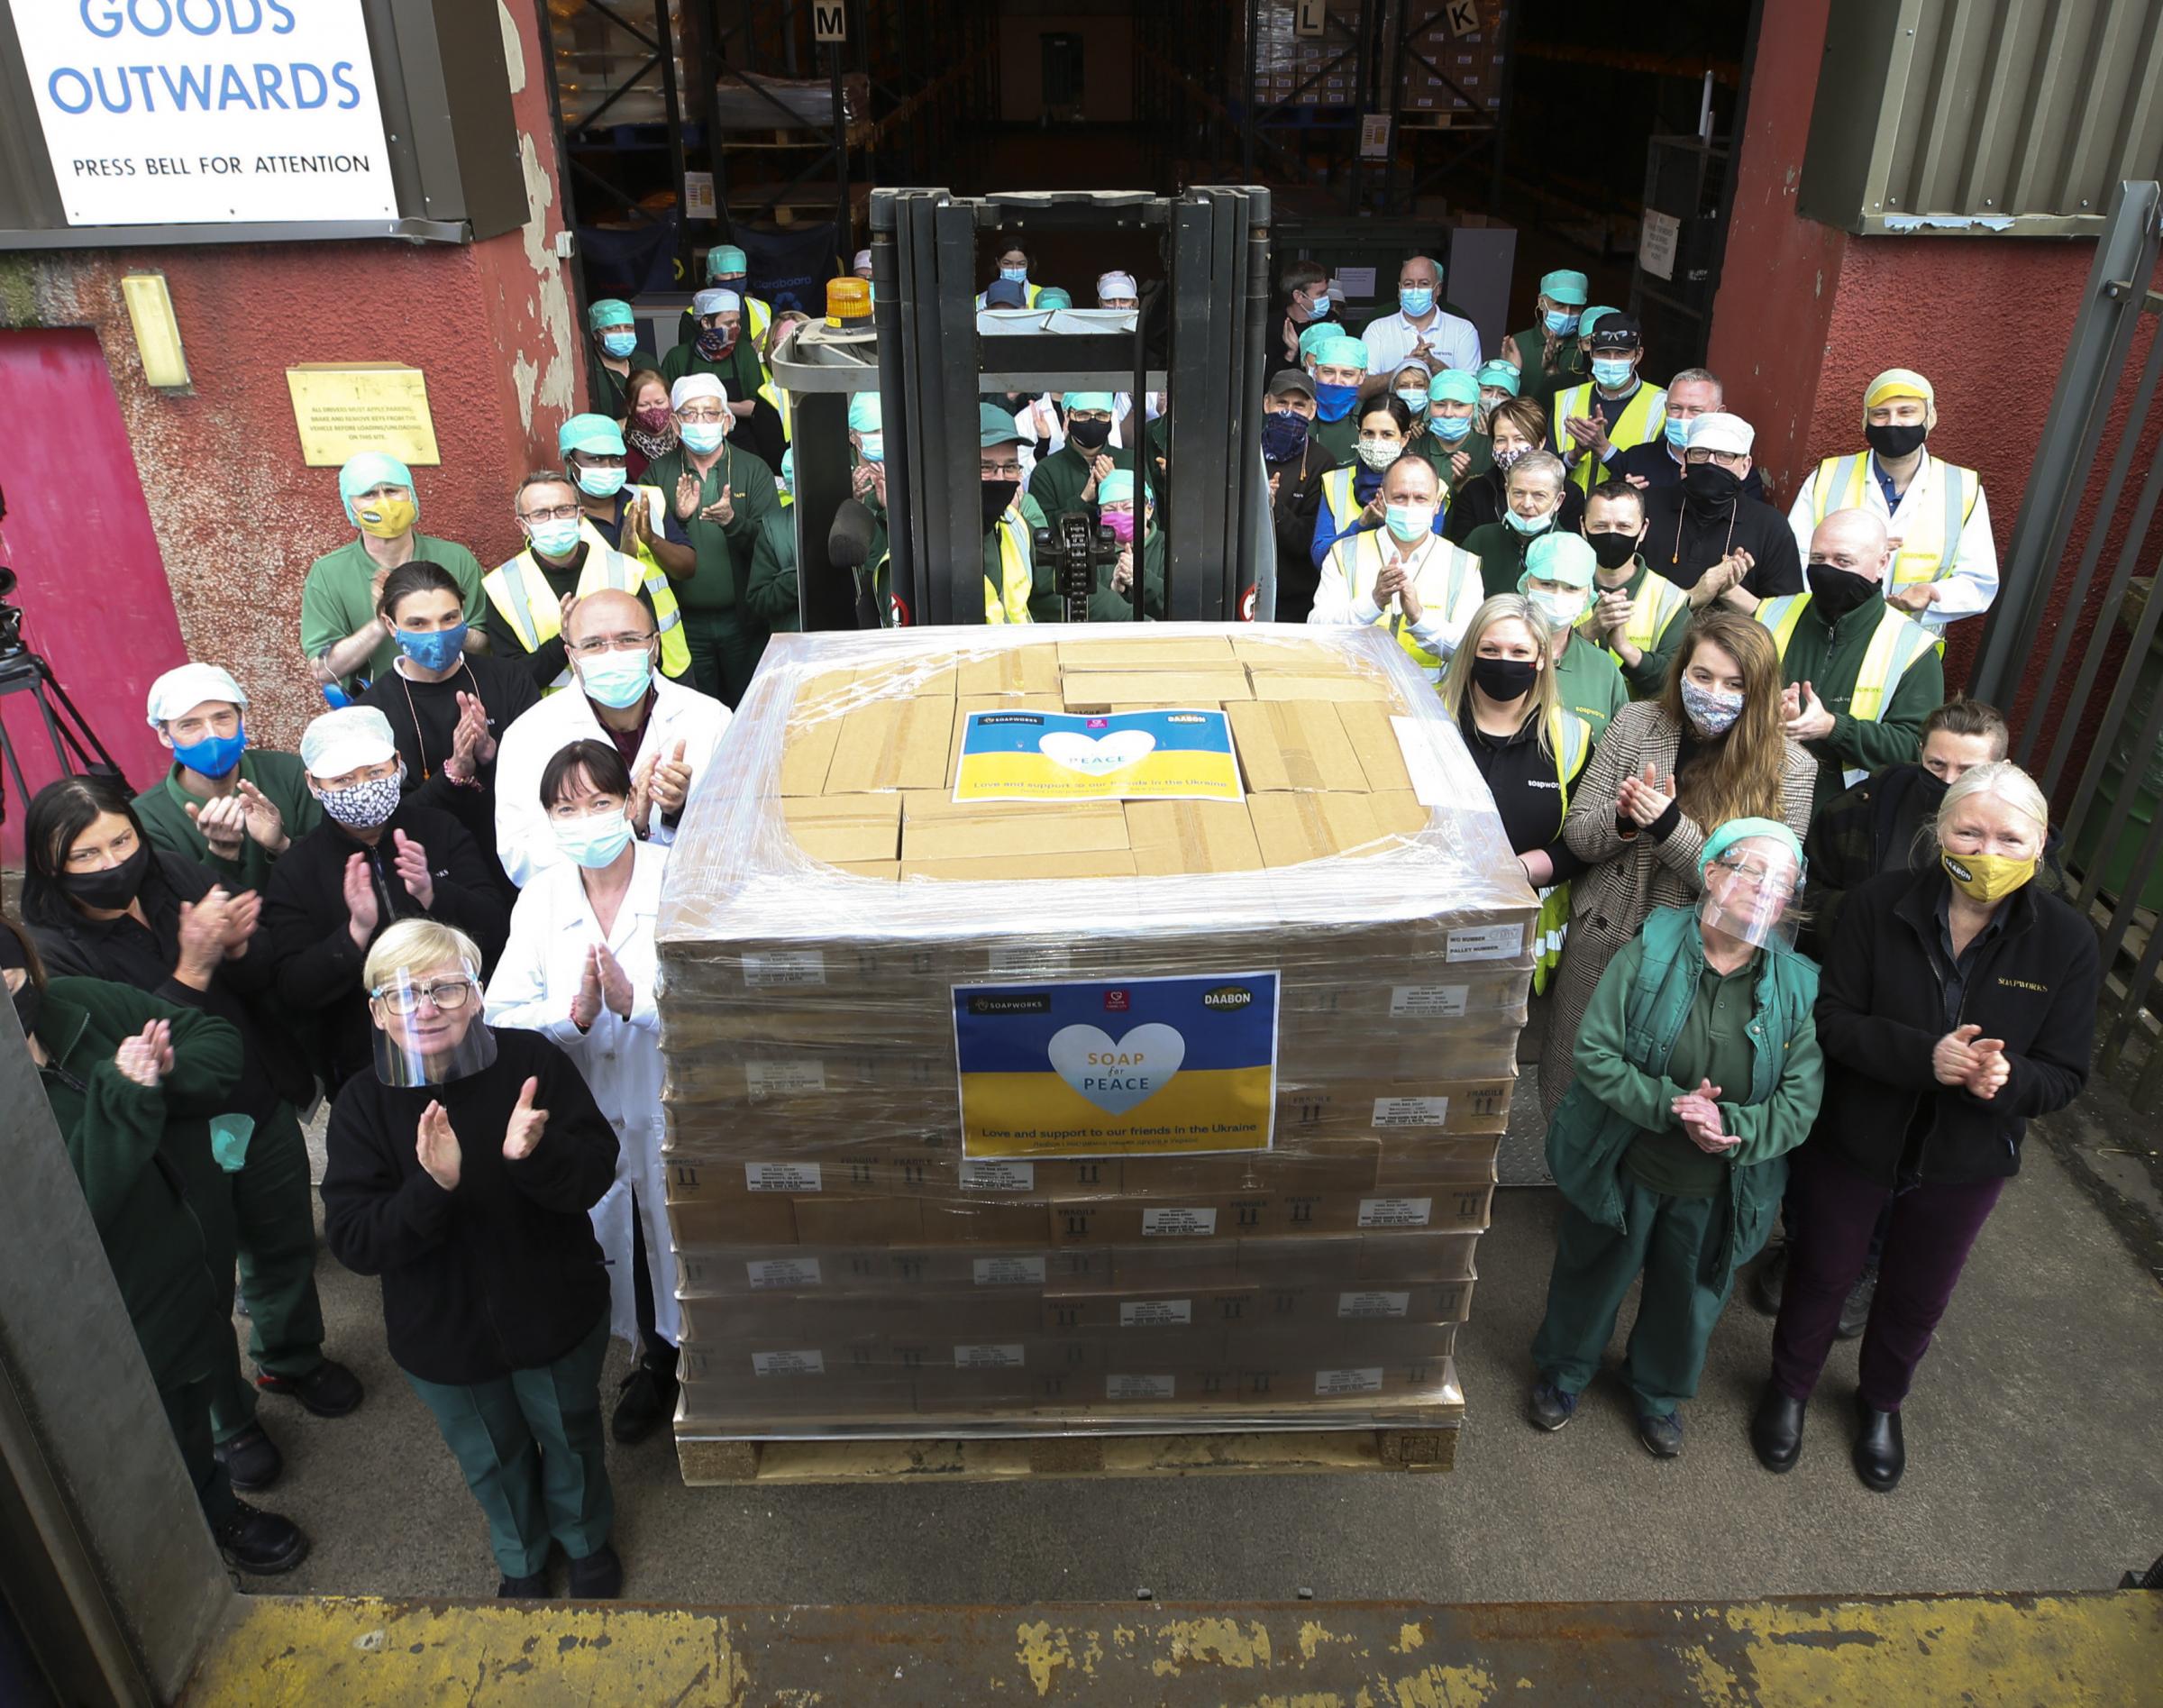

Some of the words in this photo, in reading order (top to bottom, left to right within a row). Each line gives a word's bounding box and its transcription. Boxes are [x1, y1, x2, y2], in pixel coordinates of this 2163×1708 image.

[80, 0, 297, 39] GOODS
[817, 7, 844, 35] M
[1302, 5, 1318, 29] L
[1451, 2, 1474, 31] K
[49, 61, 361, 114] OUTWARDS
[73, 158, 136, 177] PRESS
[145, 157, 192, 176] BELL
[200, 156, 243, 175] FOR
[255, 155, 371, 174] ATTENTION
[990, 1000, 1043, 1009] SOAPWORKS
[1204, 993, 1251, 1005] DAABON
[1088, 1052, 1145, 1065] SOAP
[1108, 1066, 1125, 1078] for
[1084, 1077, 1149, 1091] PEACE
[1466, 1089, 1505, 1097] FRAGILE
[981, 1128, 1010, 1138] Love
[1014, 1128, 1036, 1138] and
[1040, 1128, 1086, 1140] support
[1090, 1128, 1102, 1137] to
[1107, 1128, 1127, 1137] our
[1130, 1126, 1171, 1136] friends
[1174, 1125, 1185, 1134] in
[1190, 1124, 1209, 1134] the
[1211, 1122, 1257, 1133] Ukraine
[1058, 1208, 1096, 1216] FRAGILE
